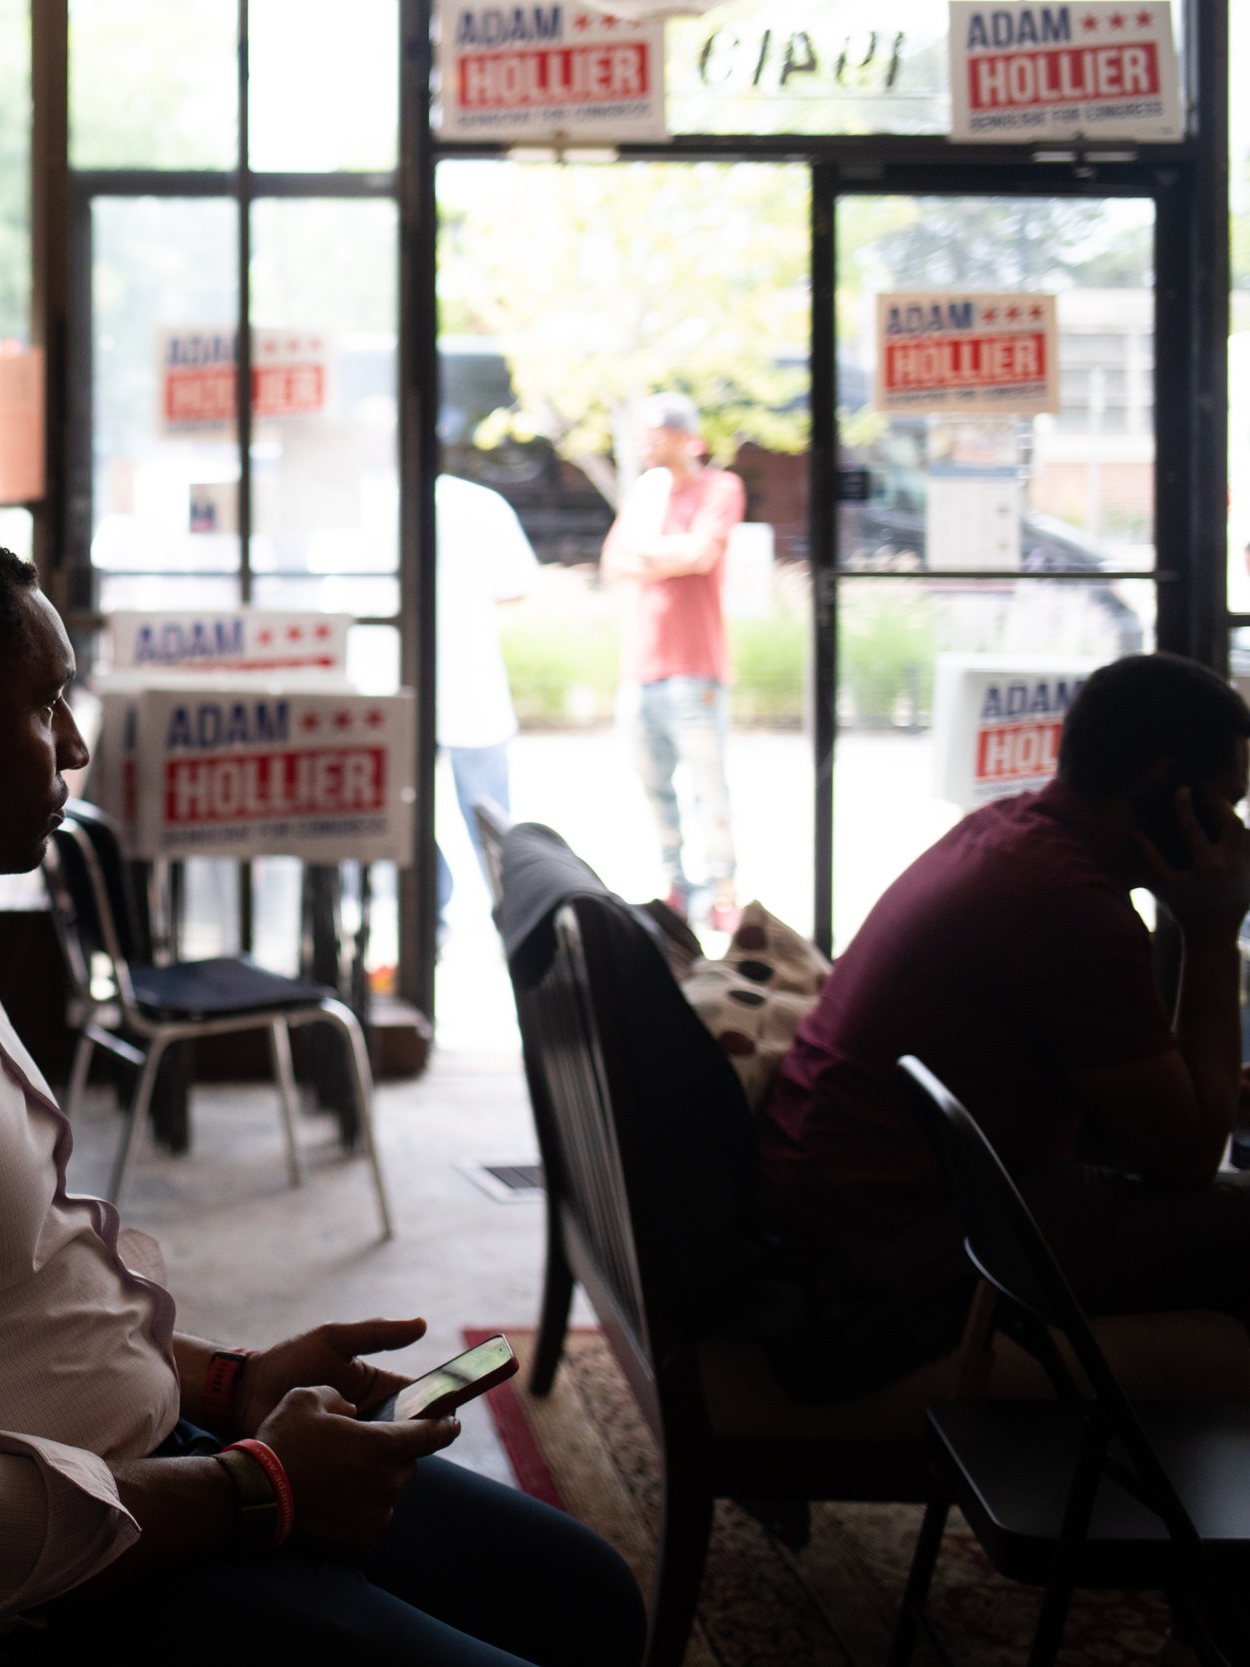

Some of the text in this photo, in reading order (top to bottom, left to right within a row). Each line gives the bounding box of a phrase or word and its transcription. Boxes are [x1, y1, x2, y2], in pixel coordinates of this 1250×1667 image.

[456, 6, 563, 45] ADAM
[967, 6, 1071, 48] ADAM
[467, 46, 641, 105] HOLLIER
[978, 47, 1149, 104] HOLLIER
[887, 302, 973, 335] ADAM
[167, 335, 238, 365] ADA
[893, 336, 1038, 387] HOLLIER
[136, 618, 245, 664] ADAM
[167, 701, 290, 748] ADAM
[175, 754, 375, 818] HOLLIER
